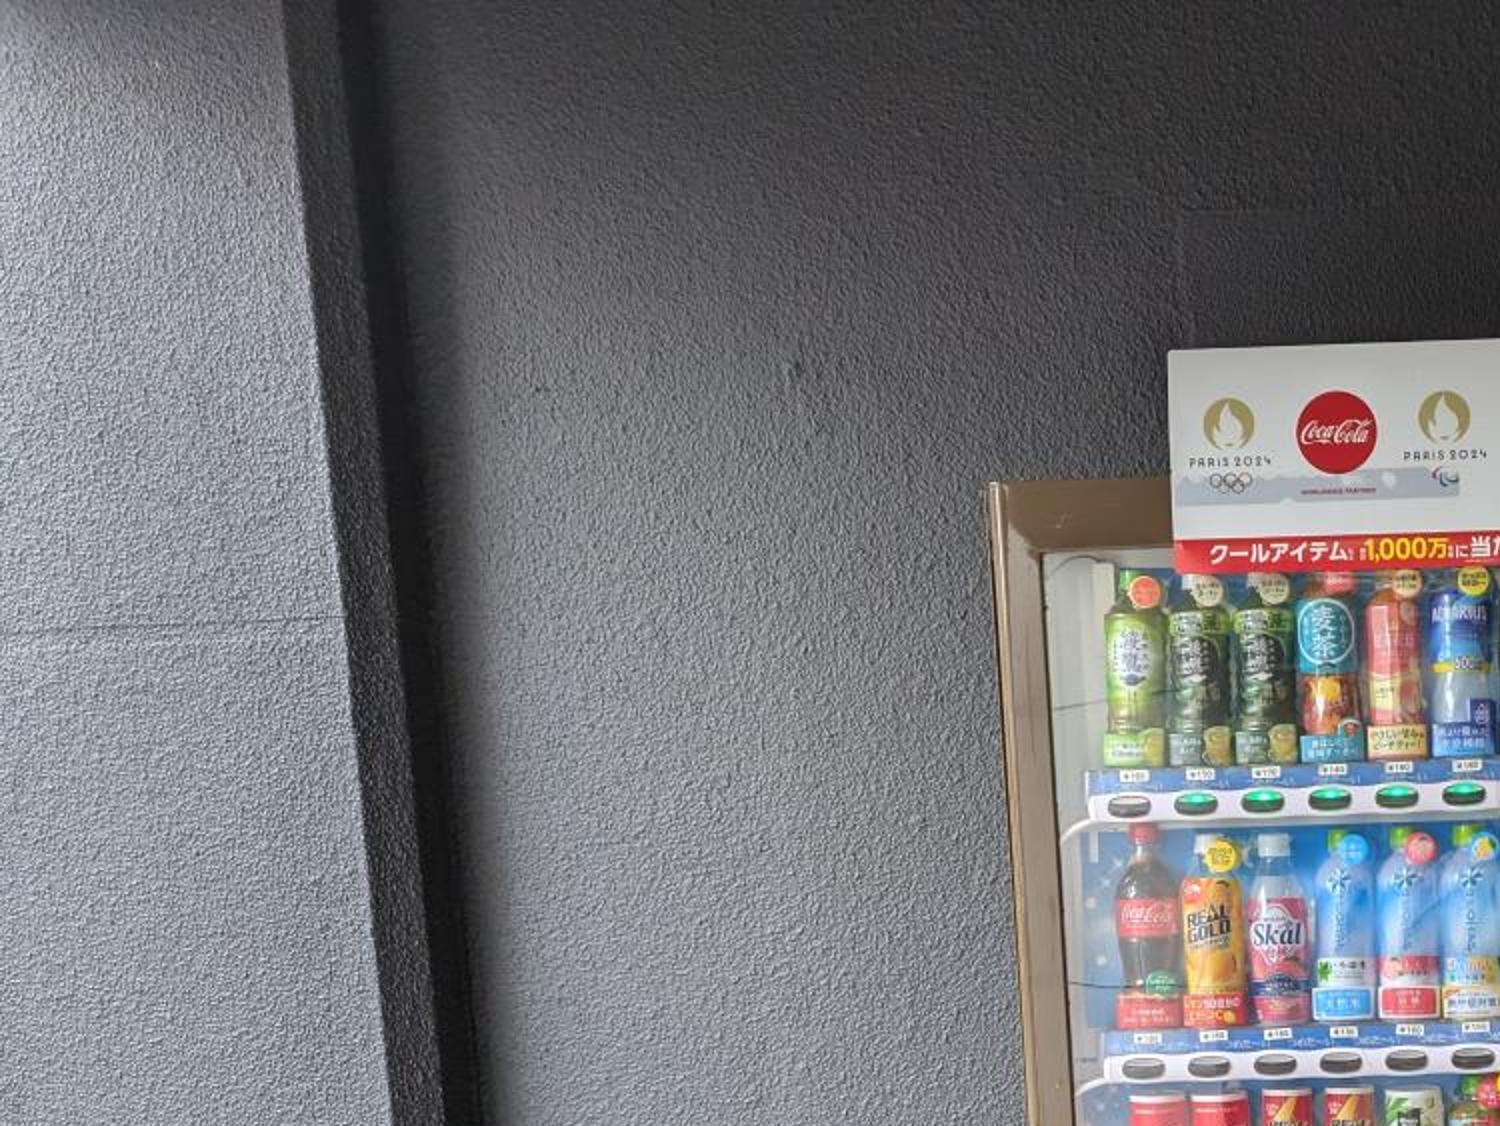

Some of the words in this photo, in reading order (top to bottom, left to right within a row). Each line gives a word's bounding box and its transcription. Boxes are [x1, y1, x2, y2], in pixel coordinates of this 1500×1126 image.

[1300, 418, 1373, 445] Coca-Cola
[1189, 457, 1229, 467] PARIS
[1233, 456, 1272, 467] 2024
[1403, 450, 1445, 461] PARIS
[1449, 449, 1488, 460] 2024
[1312, 606, 1336, 658] 麦茶
[1186, 904, 1232, 927] REAL
[1186, 919, 1232, 944] GOLD
